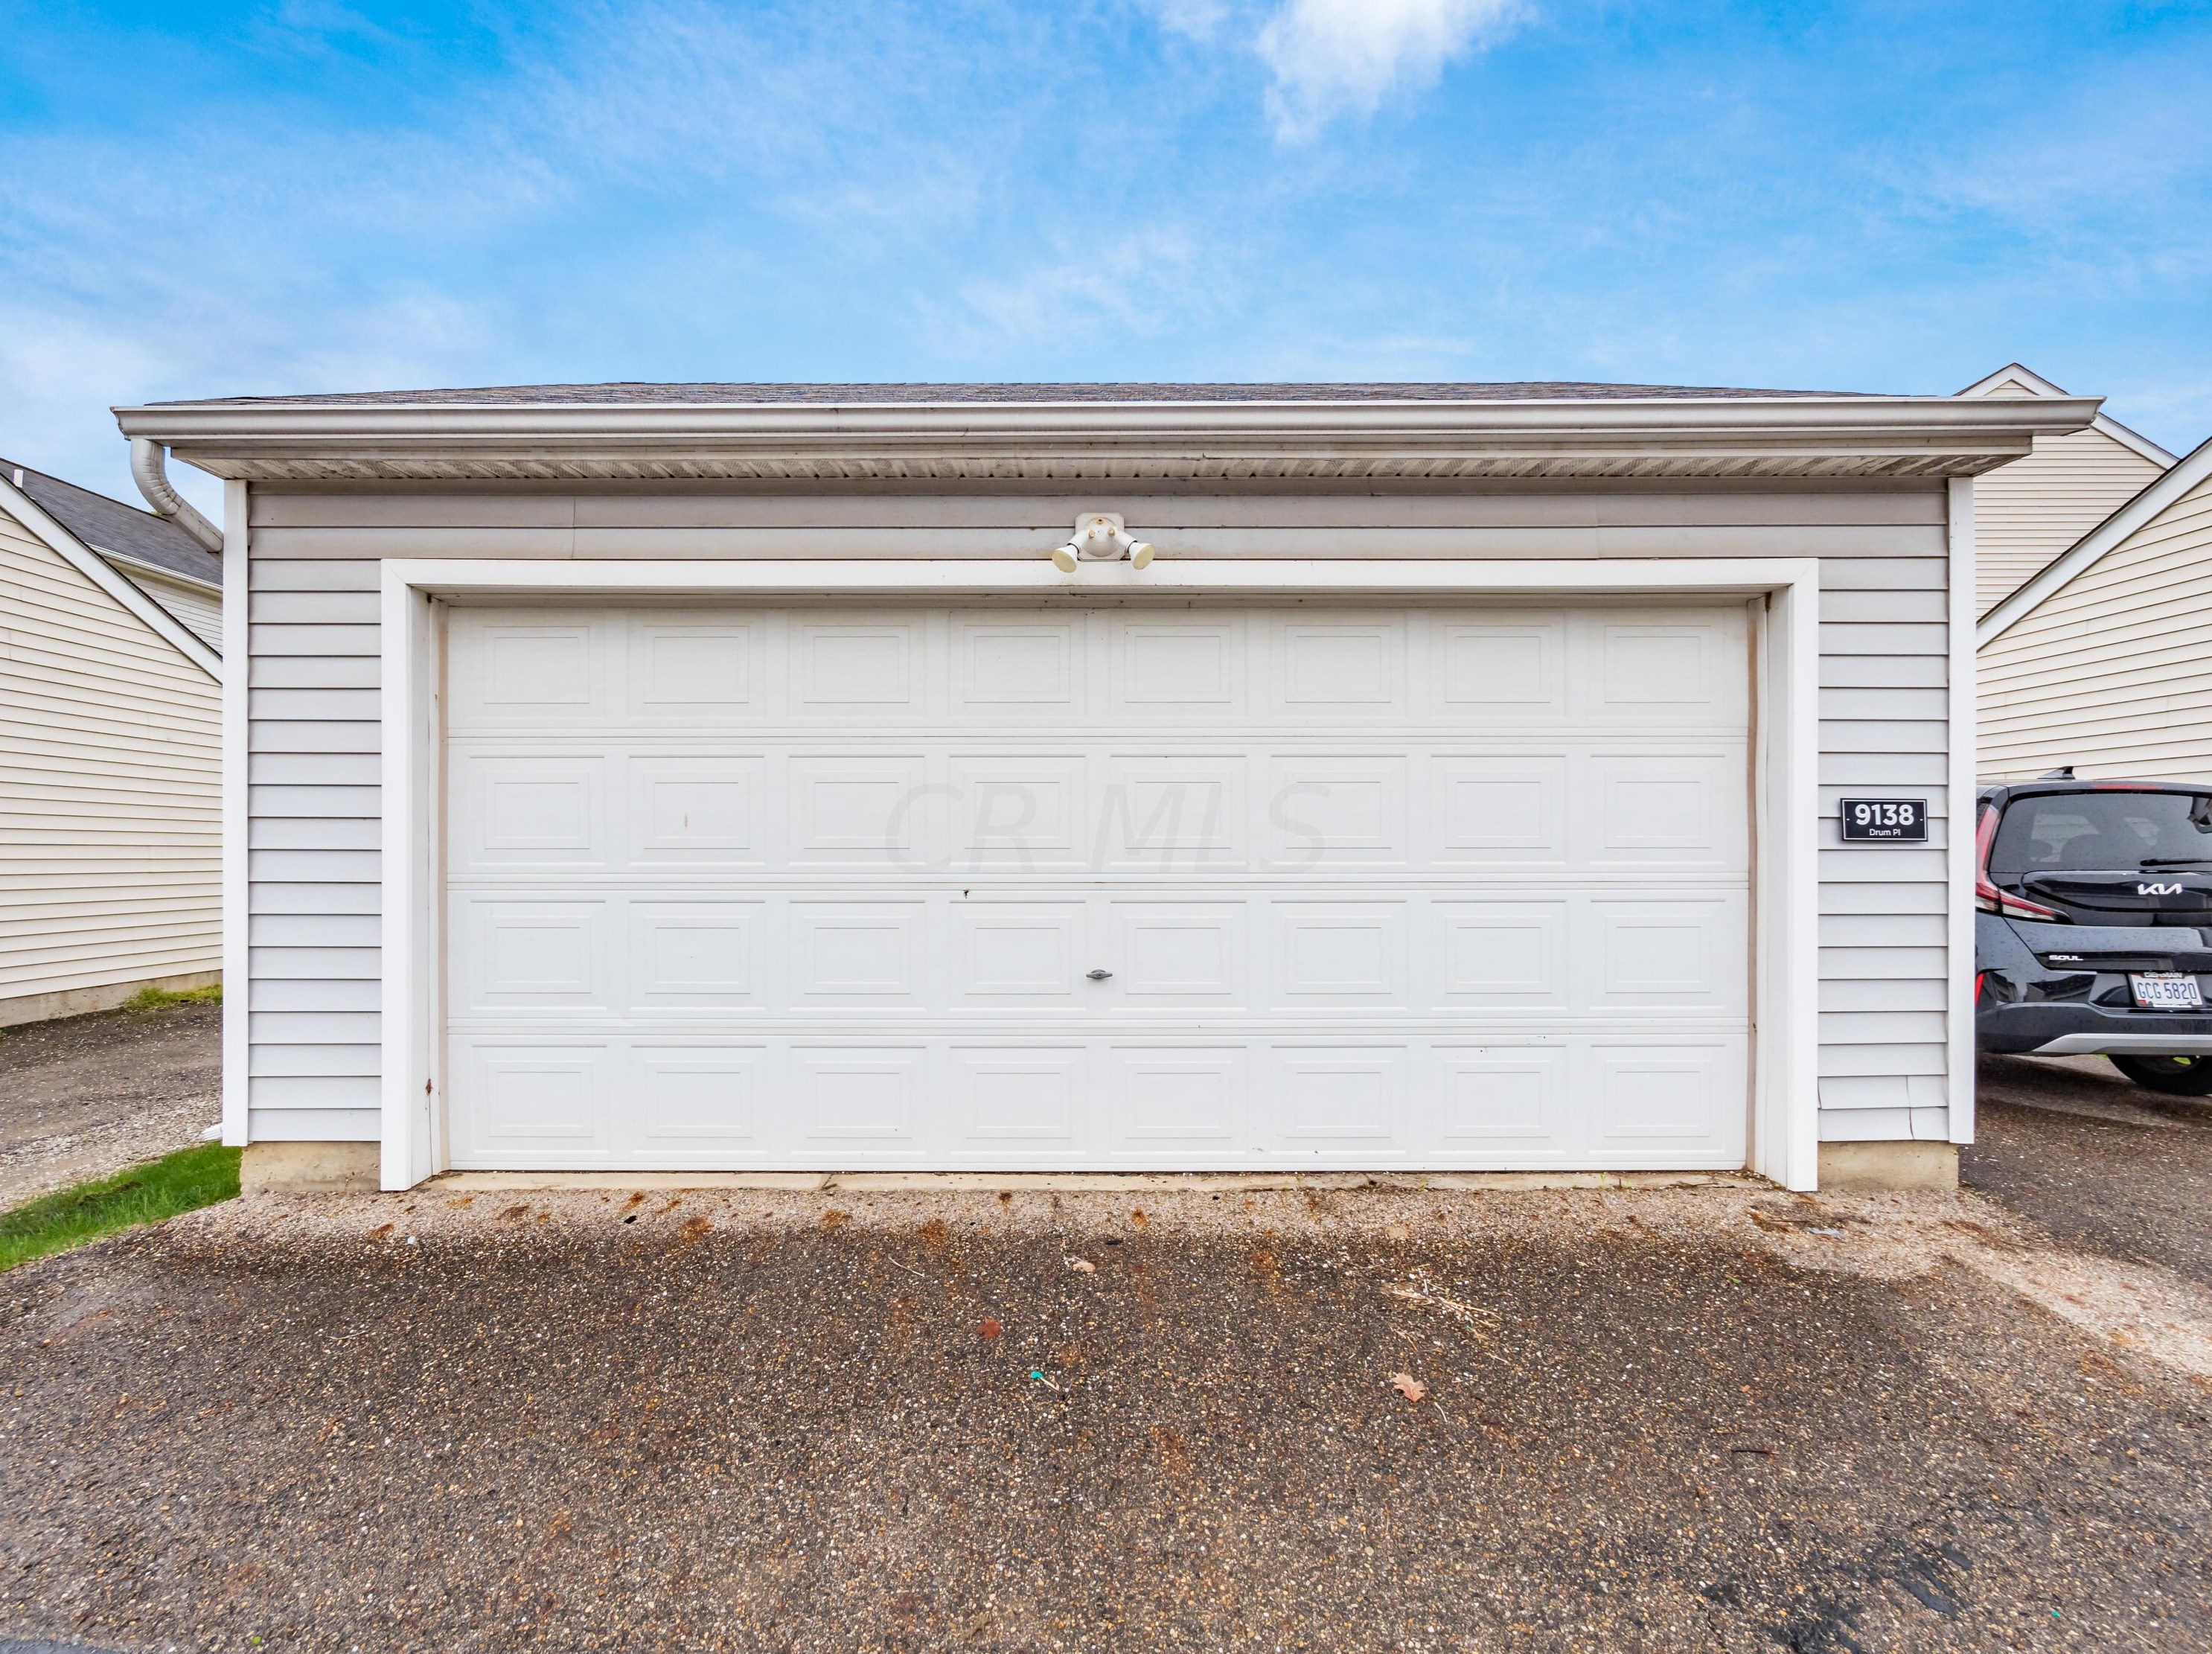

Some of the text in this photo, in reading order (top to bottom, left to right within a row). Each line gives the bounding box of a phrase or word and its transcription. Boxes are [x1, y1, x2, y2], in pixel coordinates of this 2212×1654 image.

[1855, 804, 1914, 826] 9138
[2138, 884, 2182, 895] KIA
[2138, 983, 2197, 999] GCG 5820
